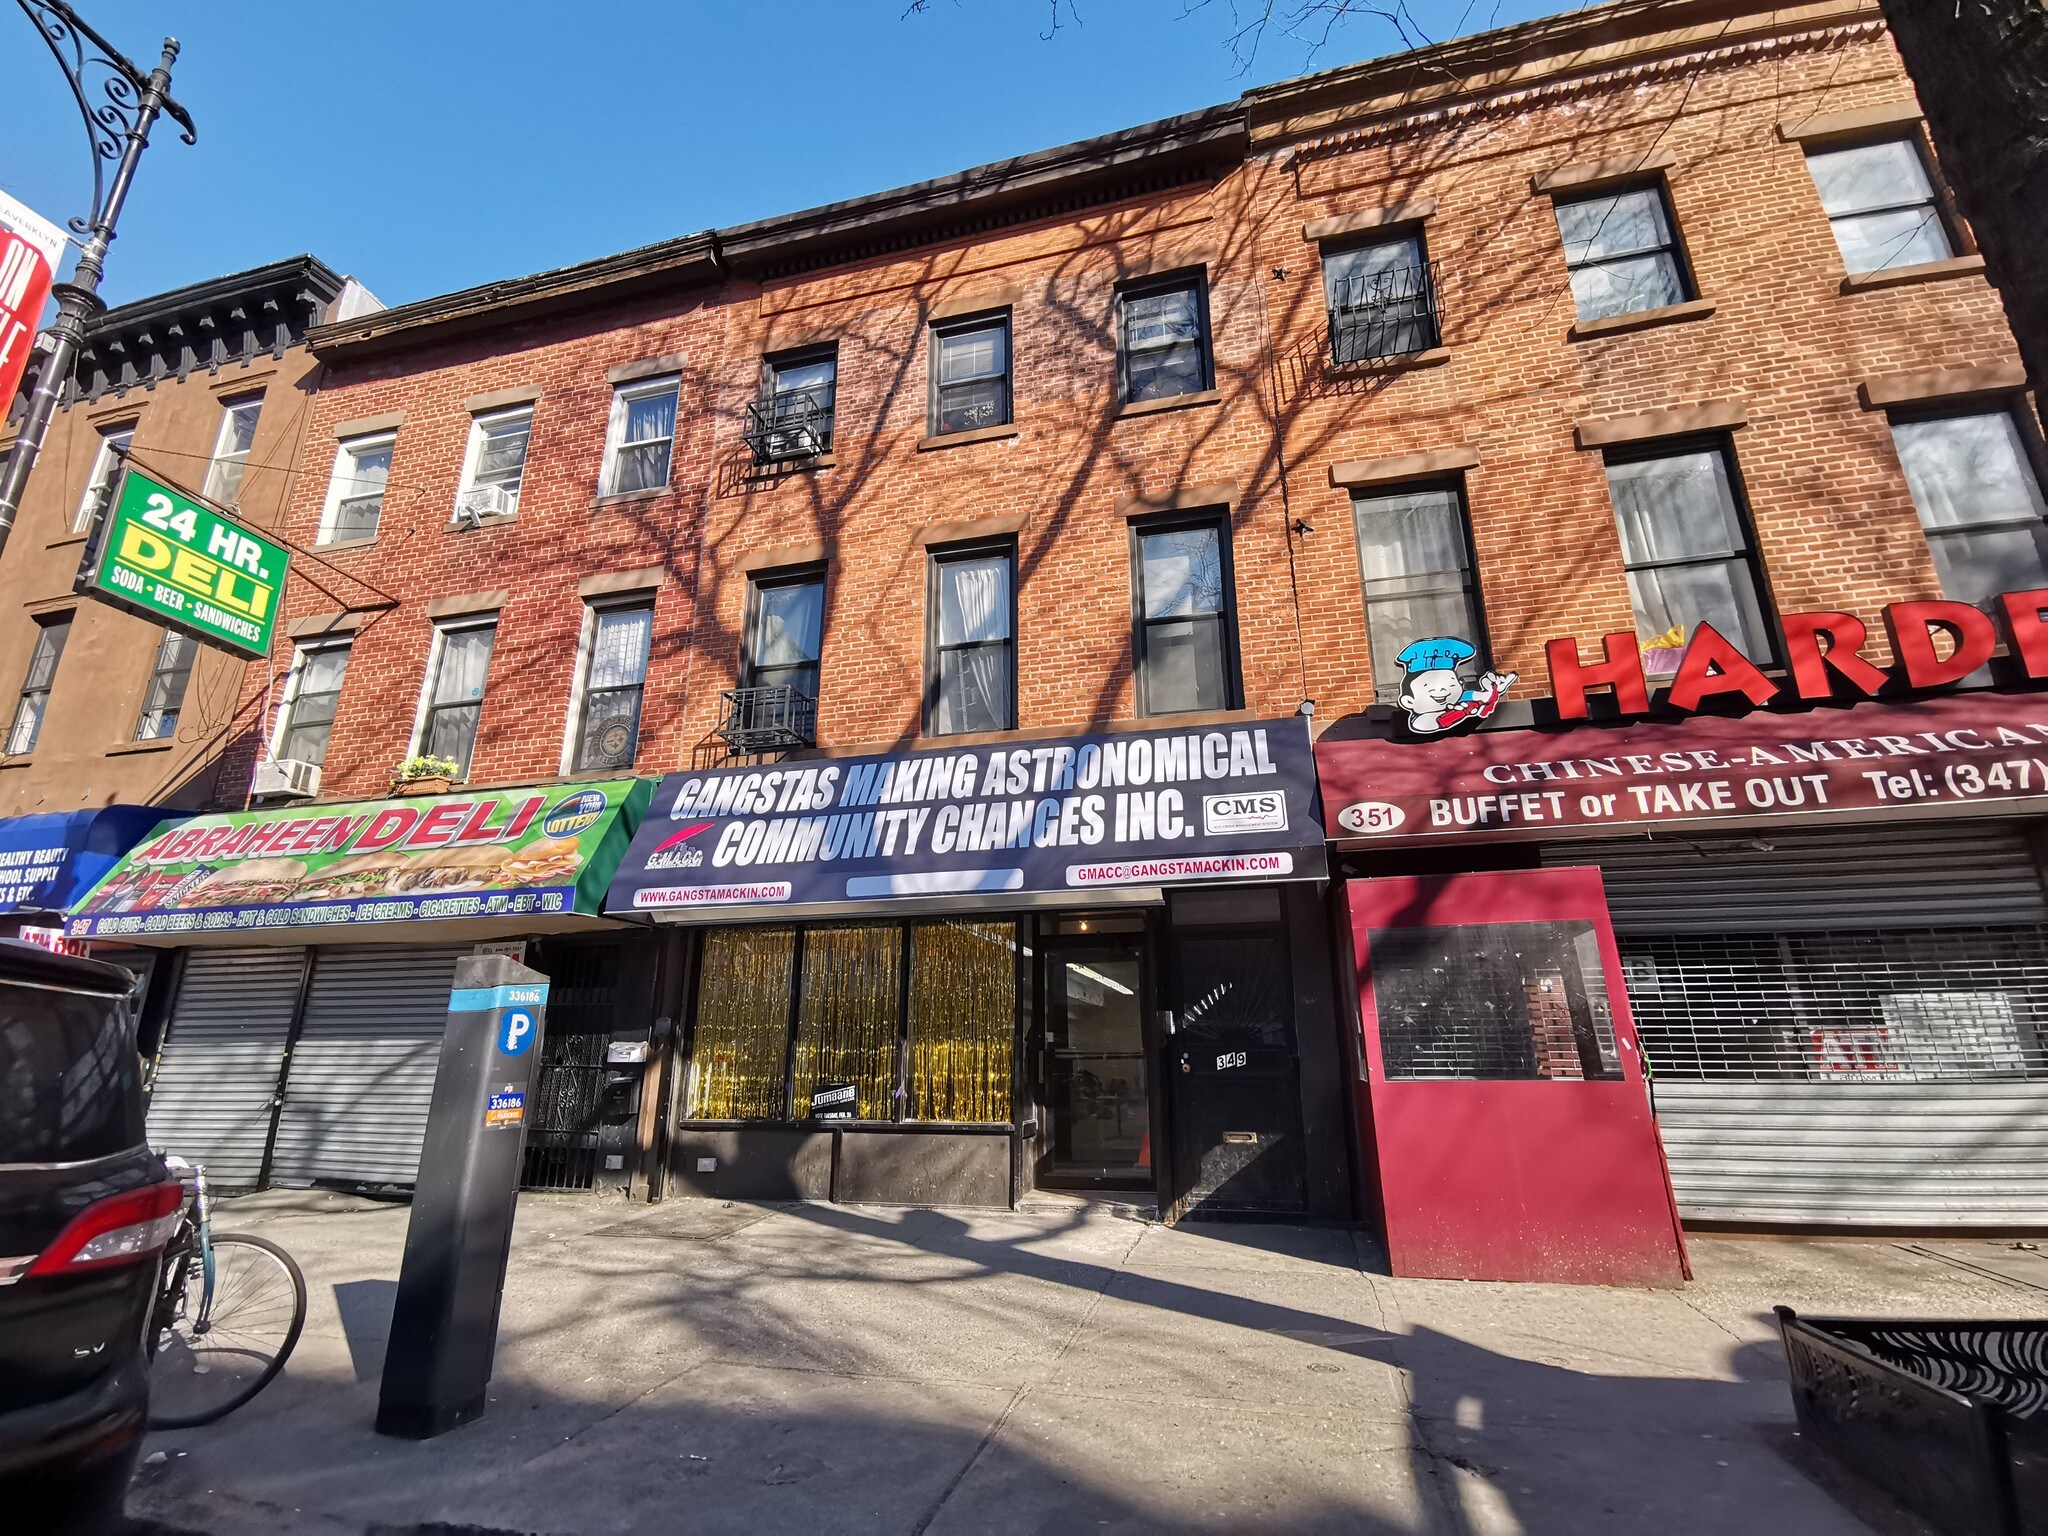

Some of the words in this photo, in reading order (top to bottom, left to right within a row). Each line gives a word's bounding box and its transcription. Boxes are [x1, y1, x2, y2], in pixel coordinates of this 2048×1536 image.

[141, 493, 197, 542] 24
[207, 523, 269, 580] HR.
[119, 525, 271, 619] DELI
[111, 565, 144, 594] SODA
[154, 584, 185, 611] BEER
[193, 601, 261, 642] SANDWICHES
[669, 765, 840, 821] GANGSTAS
[839, 753, 979, 807] MAKING
[981, 729, 1277, 796] ASTRONOMICAL
[578, 801, 602, 815] YORK
[580, 794, 600, 803] NEW
[1213, 797, 1277, 816] CMS
[1429, 791, 1566, 826] BUFFET
[1580, 795, 1617, 817] or
[1627, 779, 1736, 814] TAKE
[1745, 774, 1829, 809] OUT
[1862, 769, 1938, 799] Tel:
[546, 811, 600, 833] LOTTERY
[1350, 807, 1395, 827] 351
[130, 815, 368, 866] ABRAHEEN
[346, 795, 548, 855] DELI
[711, 805, 931, 868] COMMUNITY
[931, 795, 1105, 854] CHANGES
[1114, 788, 1195, 842] INC.
[33, 847, 69, 864] BEAUTY
[23, 866, 59, 883] SUPPLY
[1078, 856, 1280, 881] GMACC@GANGSTAMACKIN.COM
[7, 886, 15, 902] &
[640, 884, 786, 903] WWW.GANGSTAMACKIN.COM
[71, 918, 91, 935] 347
[97, 917, 118, 934] COLD
[118, 916, 141, 934] CUTS
[144, 914, 168, 932] COLD
[167, 913, 195, 931] BEERS
[195, 912, 202, 929] &
[203, 911, 233, 928] SODAS
[236, 910, 257, 927] HOT
[256, 910, 264, 925] &
[265, 908, 290, 924] COLD
[290, 905, 351, 924] SANDWICHES
[355, 903, 374, 920] ICE
[374, 901, 414, 919] CREAMS
[419, 897, 480, 918] CIGARETTES
[485, 895, 508, 914] ATM
[514, 894, 536, 912] EBT
[542, 893, 562, 910] WIC
[509, 990, 539, 1002] 336186
[506, 1014, 530, 1050] P
[1217, 1052, 1246, 1070] 349
[491, 1097, 521, 1109] 336186
[812, 1085, 856, 1106] Jumaane
